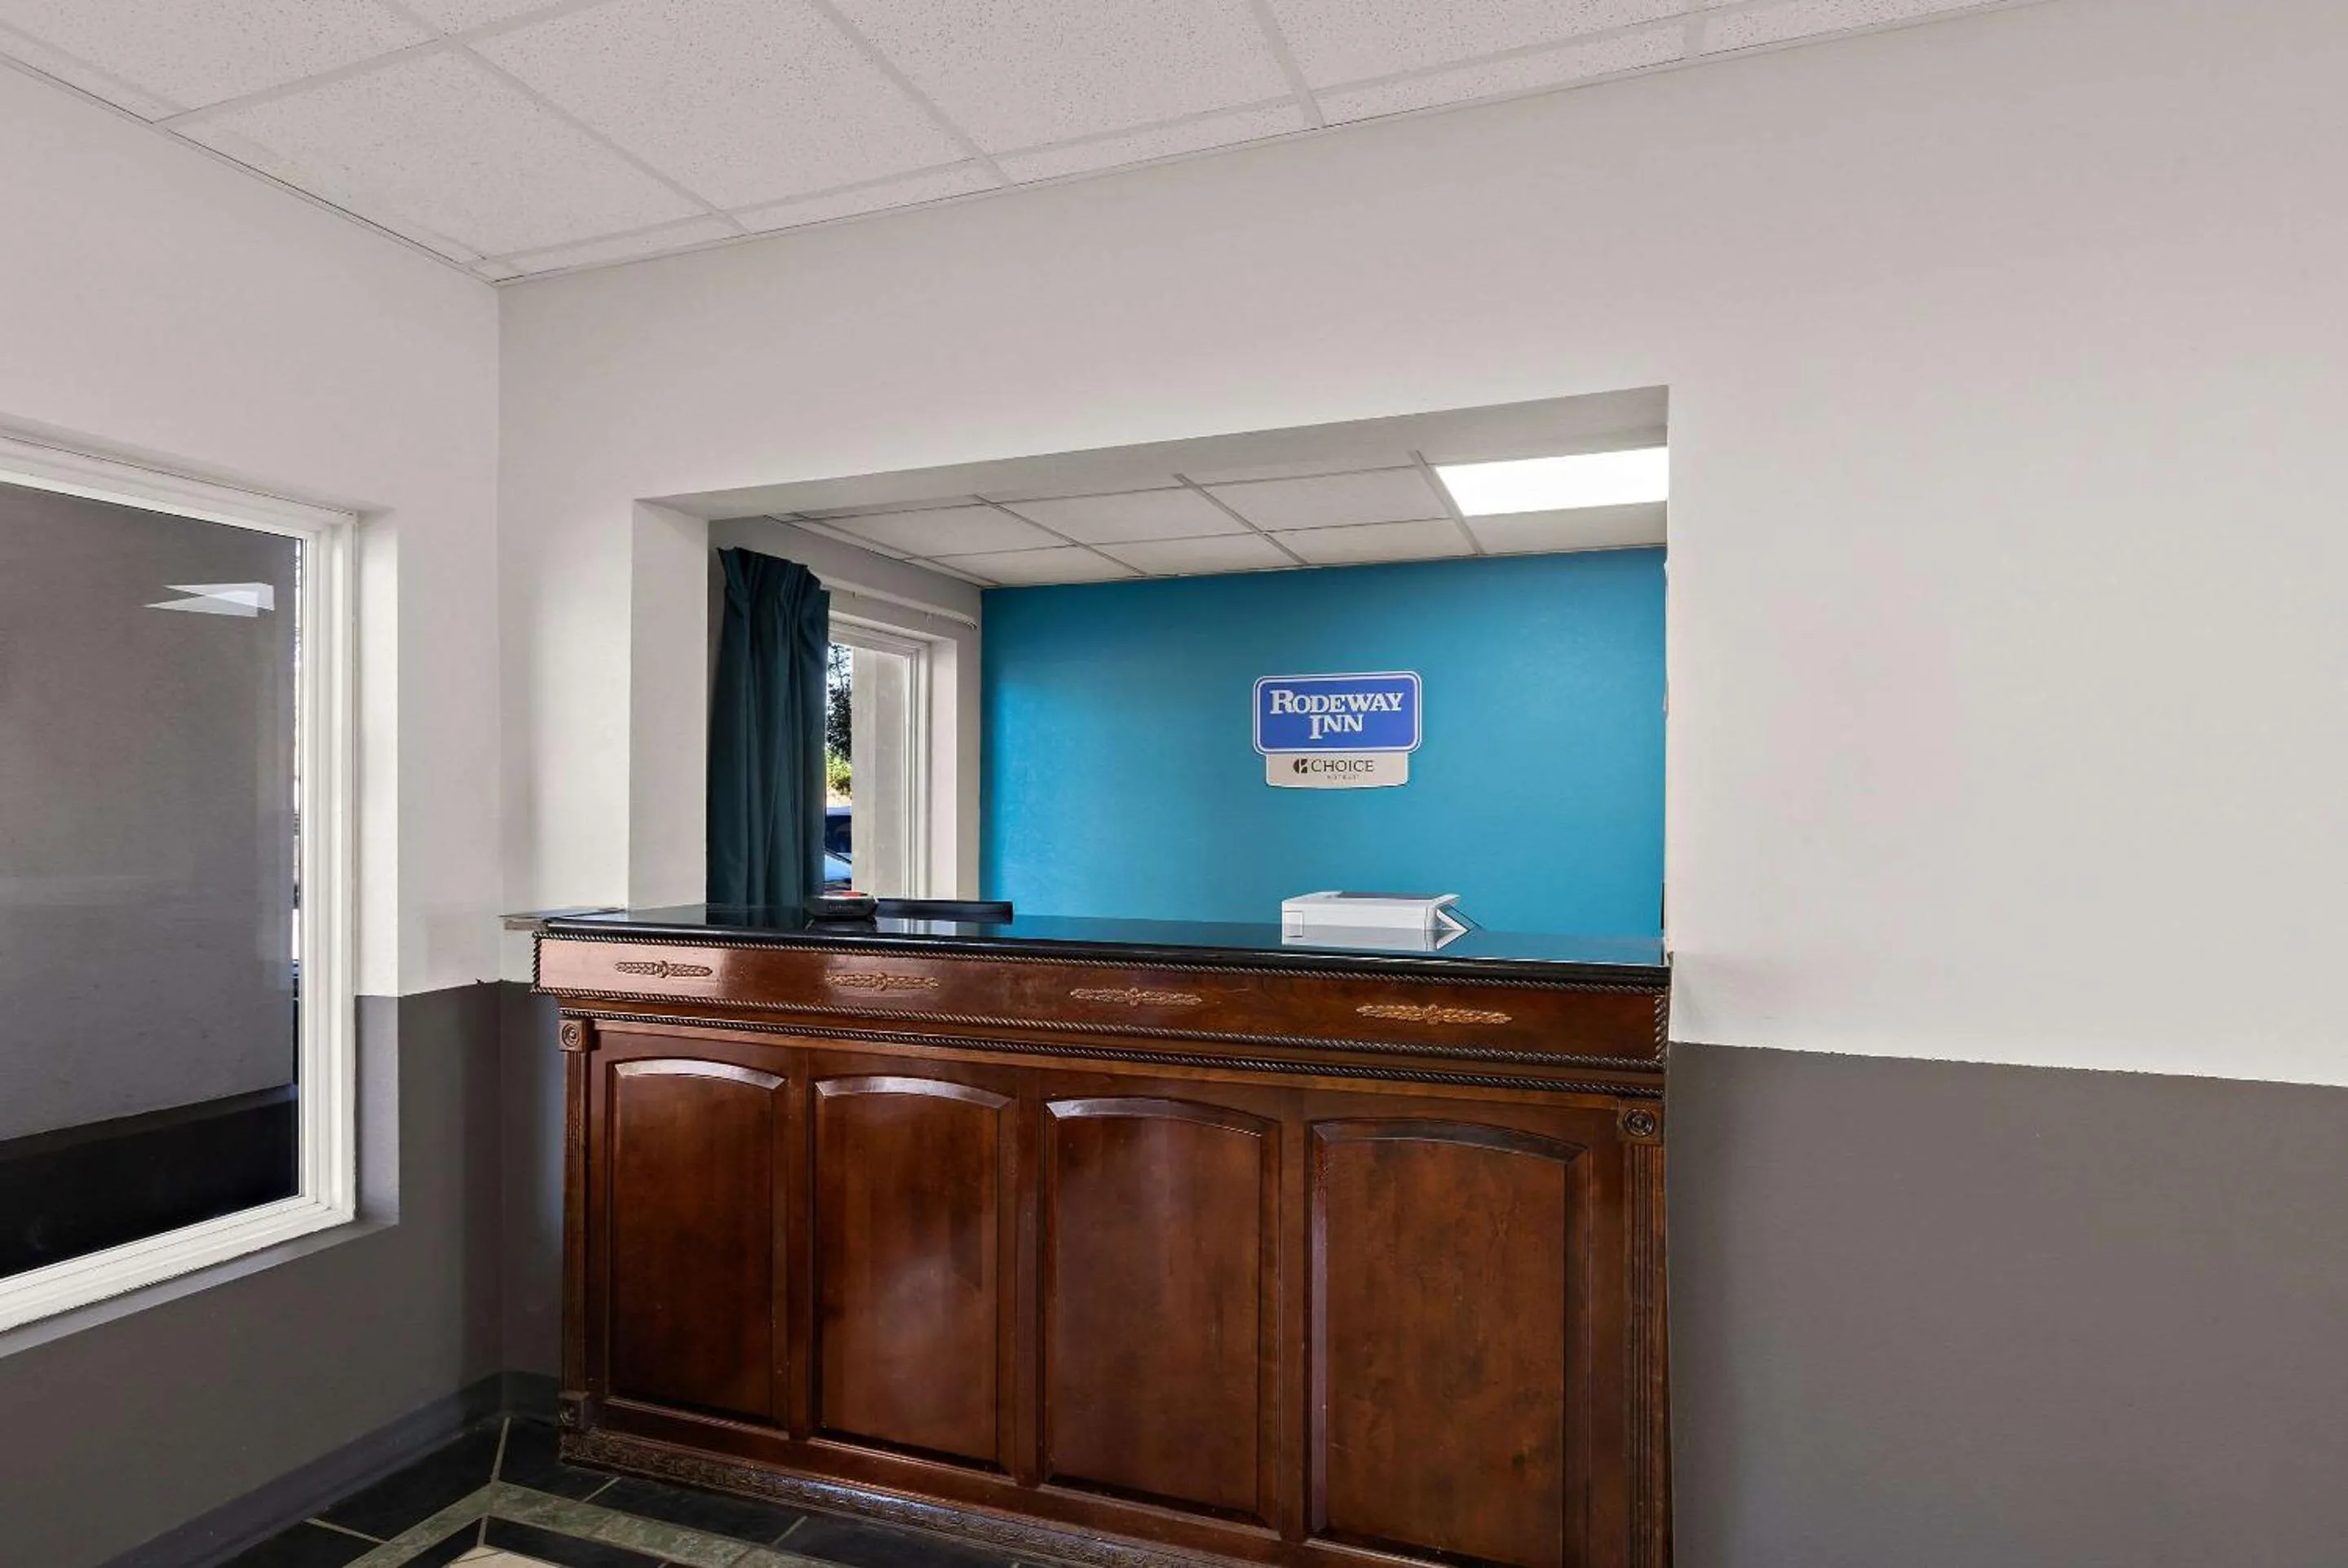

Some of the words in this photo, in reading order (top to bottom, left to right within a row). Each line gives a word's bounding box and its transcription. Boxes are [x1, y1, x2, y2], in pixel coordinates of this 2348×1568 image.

[1269, 689, 1404, 715] RODEWAY
[1309, 714, 1364, 740] INN
[1311, 758, 1375, 772] CHOICE
